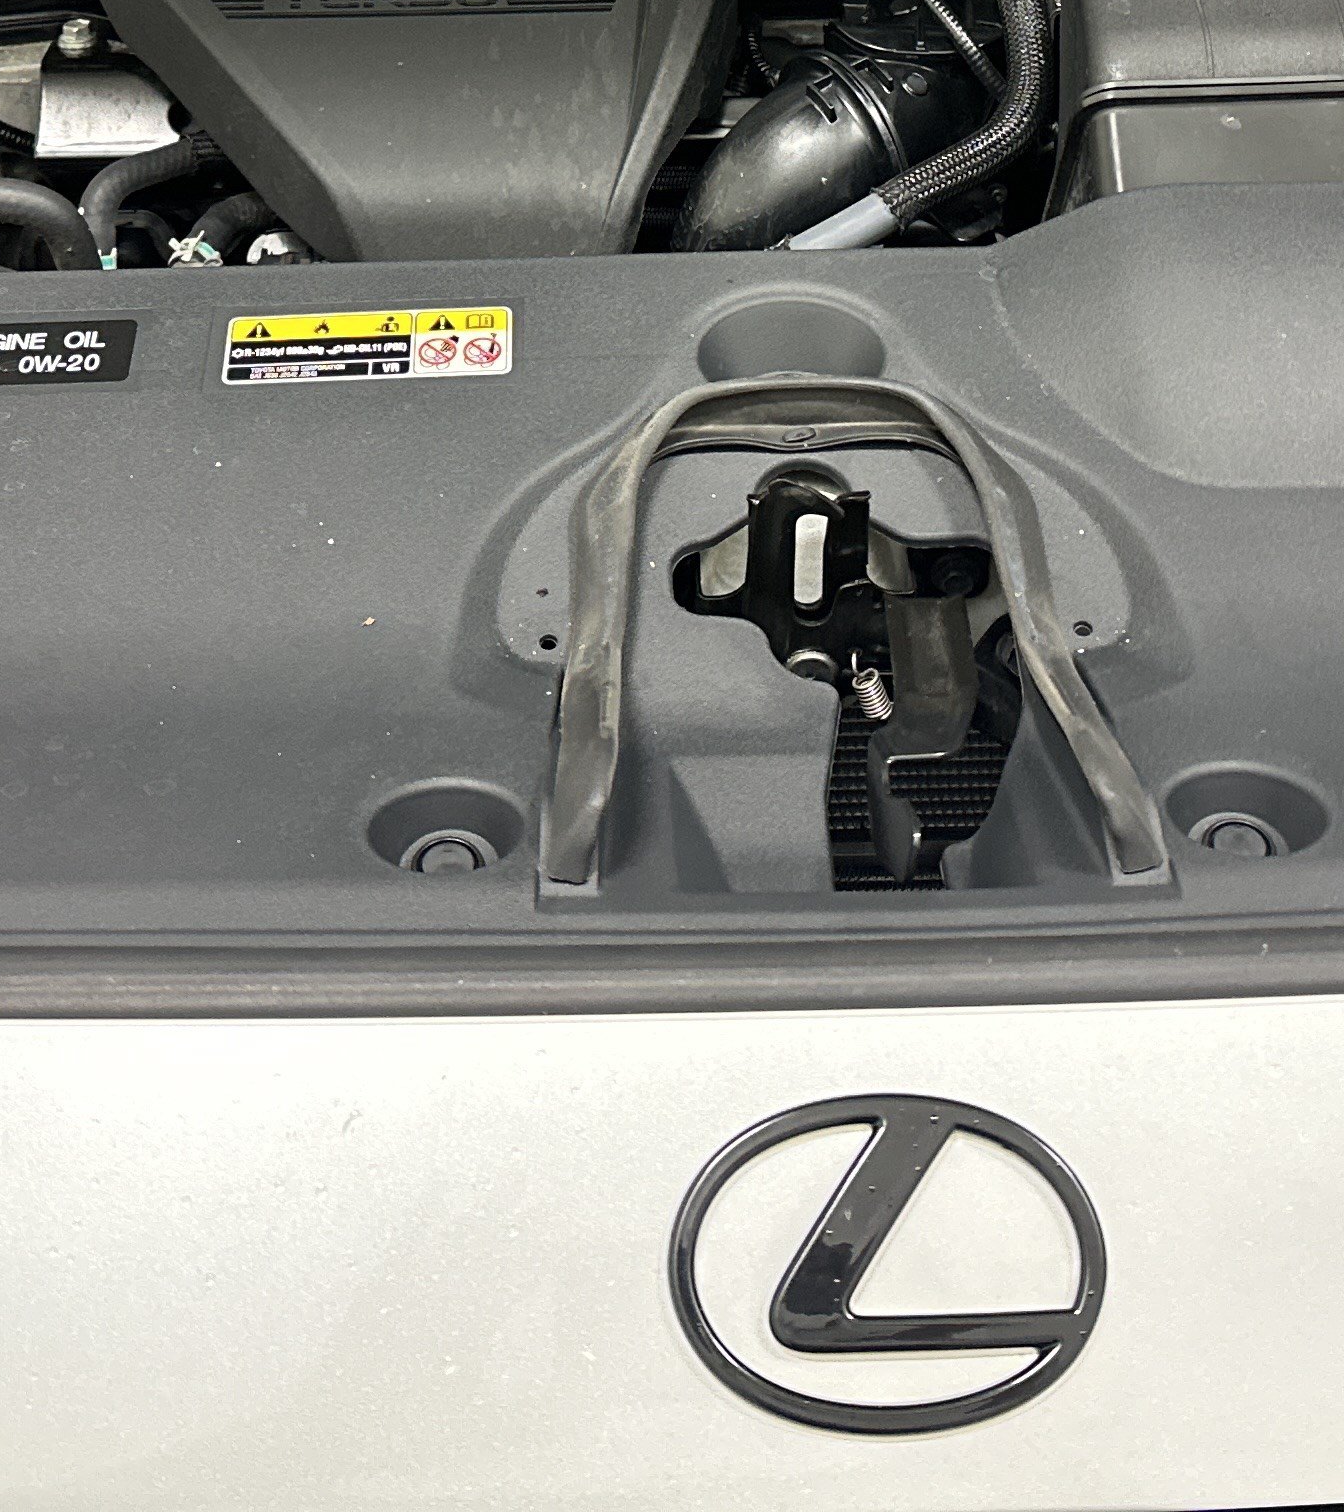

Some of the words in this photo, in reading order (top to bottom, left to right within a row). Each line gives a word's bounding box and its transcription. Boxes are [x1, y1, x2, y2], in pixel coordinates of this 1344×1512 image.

[63, 330, 106, 349] OIL
[17, 353, 101, 374] 0W-20
[382, 362, 400, 373] VR
